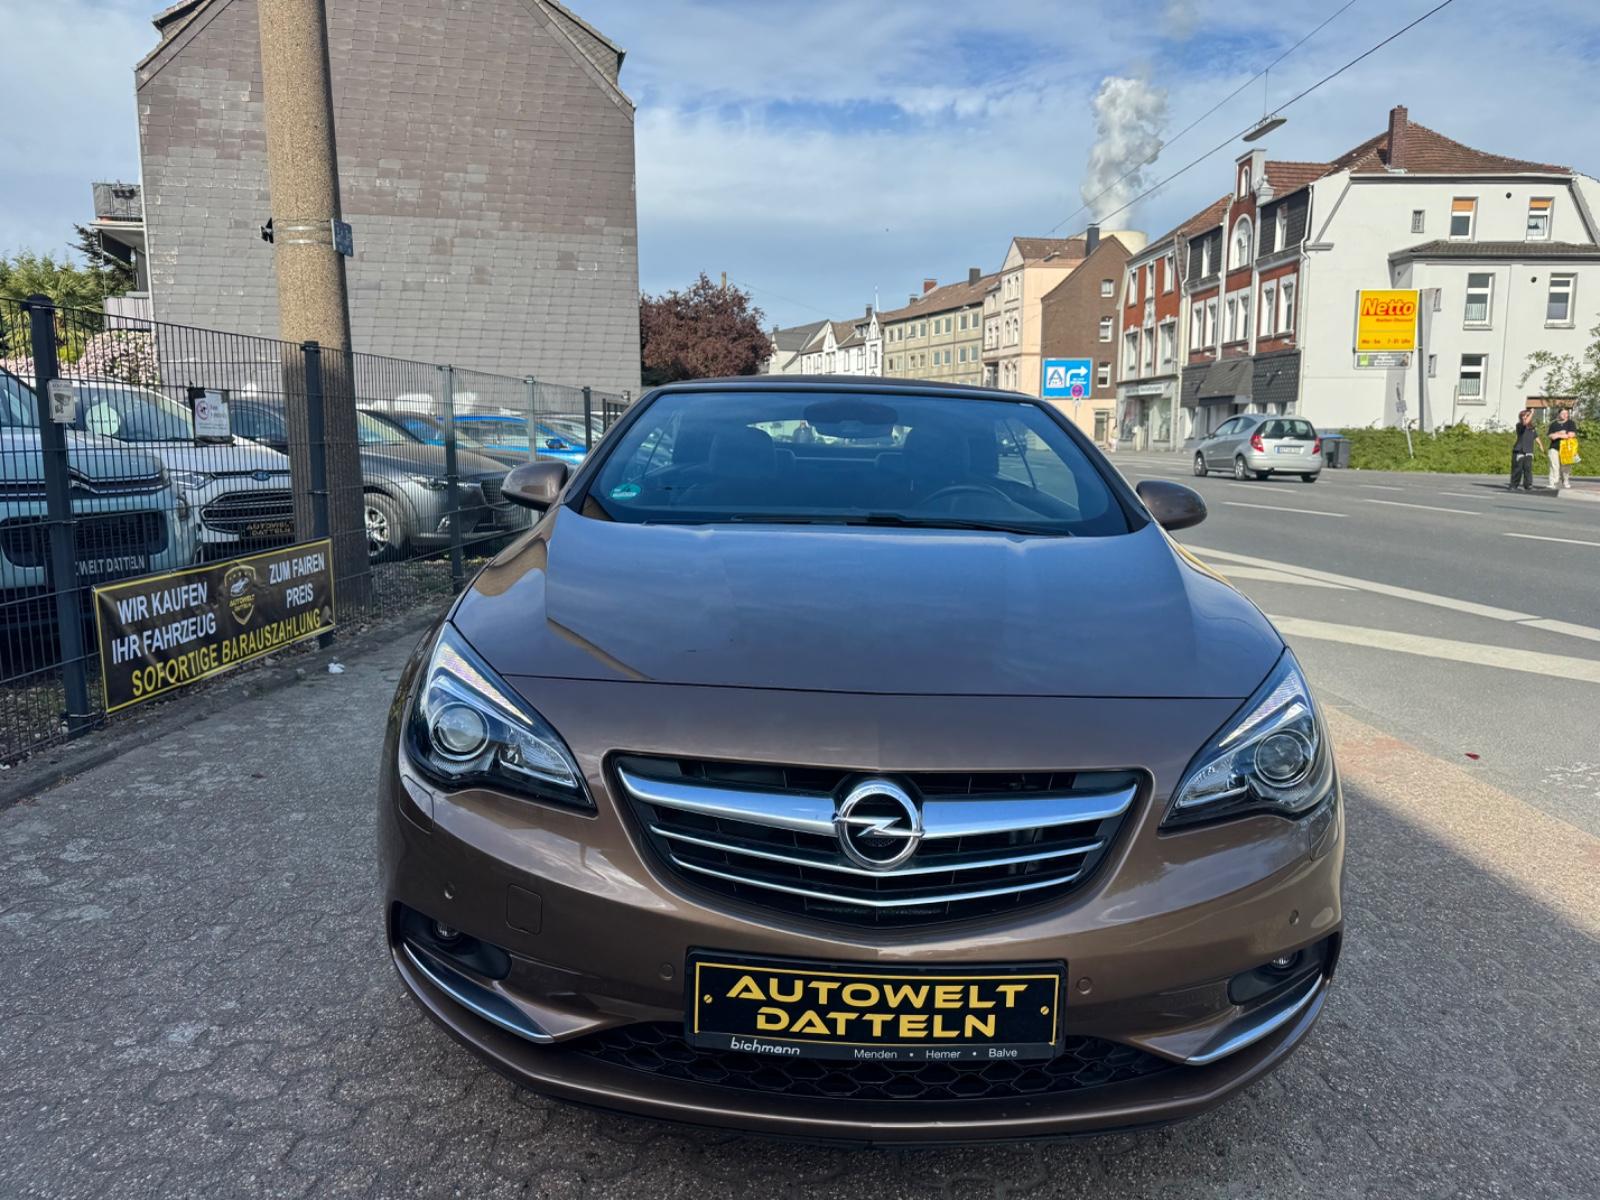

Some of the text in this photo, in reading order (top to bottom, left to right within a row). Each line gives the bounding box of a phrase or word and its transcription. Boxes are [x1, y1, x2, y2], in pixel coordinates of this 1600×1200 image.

[1361, 298, 1415, 316] Netto
[105, 555, 146, 573] DATTELN
[269, 552, 326, 585] ZUM FAIREN
[117, 582, 208, 625] WIR KAUFEN
[286, 583, 314, 609] PREIS
[111, 612, 216, 664] IHR FAHRZEUG
[131, 608, 321, 696] SOFORTIGE BARAUSZAHLUNG
[726, 974, 1028, 1009] AUTOWELT
[756, 1006, 996, 1038] DATTELN
[730, 1037, 800, 1055] bichmann
[854, 1047, 1018, 1060] Menden Hemer Balve
